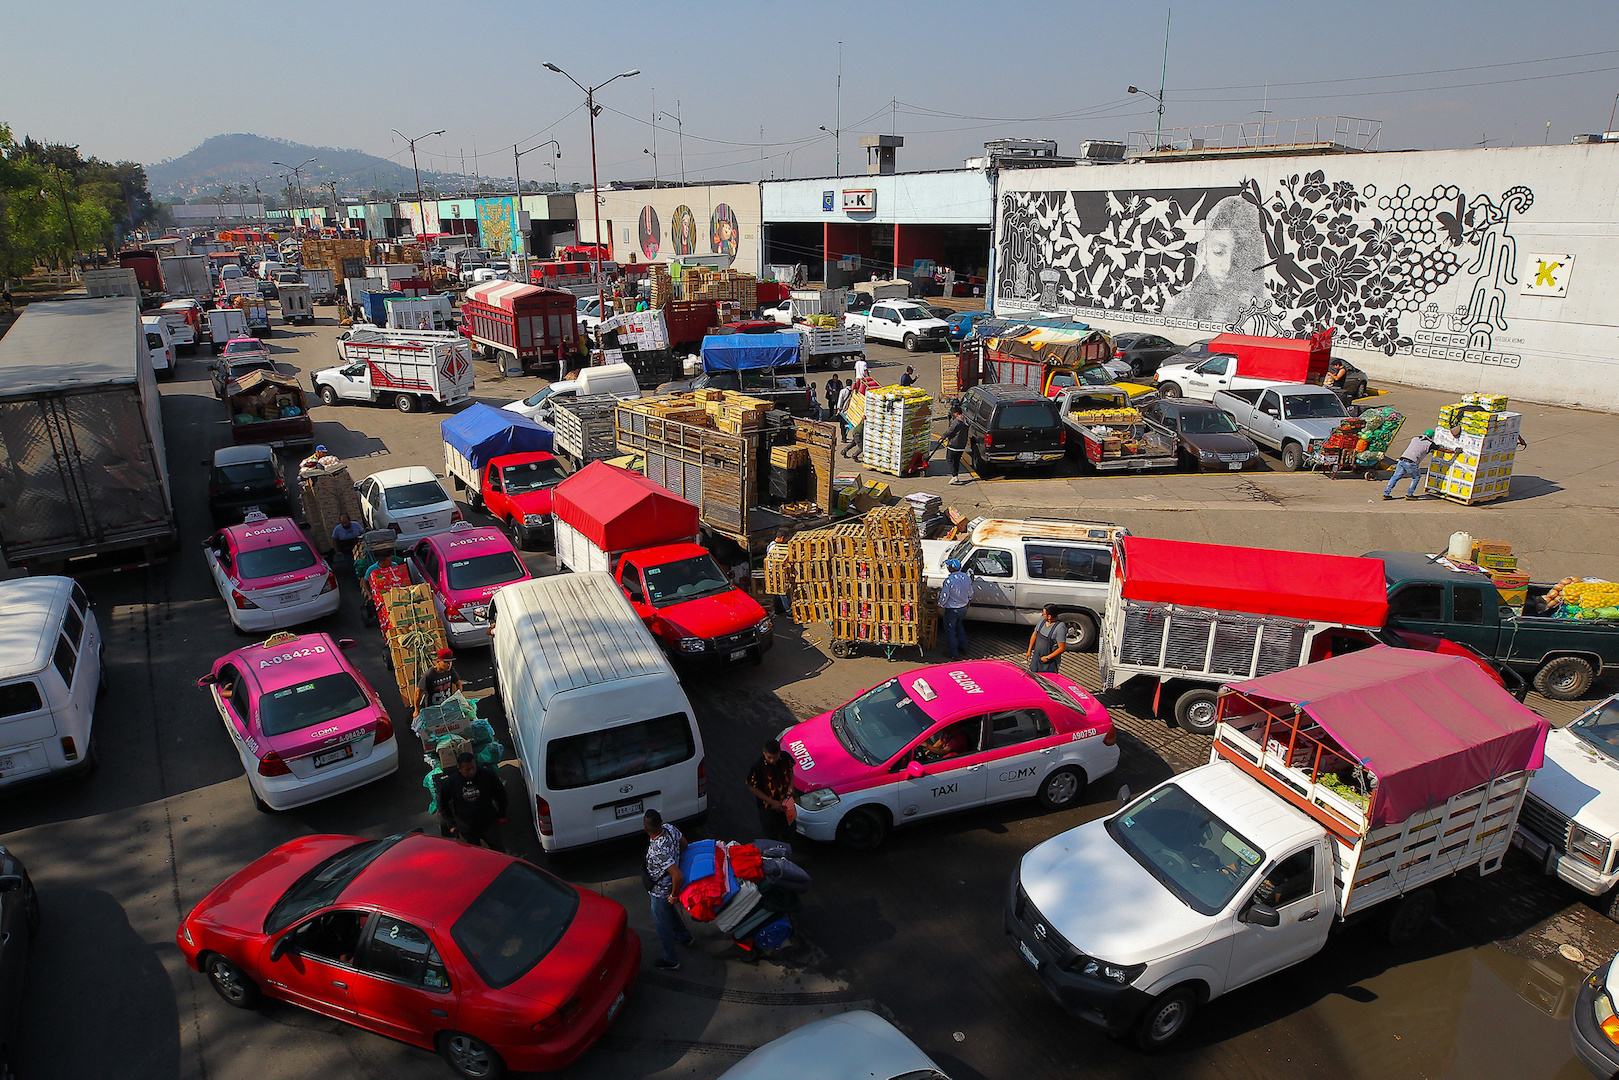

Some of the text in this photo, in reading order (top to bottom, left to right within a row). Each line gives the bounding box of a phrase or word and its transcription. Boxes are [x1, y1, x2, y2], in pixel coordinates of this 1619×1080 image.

[1536, 261, 1560, 287] K
[260, 646, 326, 669] A-0842-D
[948, 670, 985, 694] A9075D
[310, 726, 339, 738] CDMX
[1072, 728, 1097, 741] A9075D
[788, 740, 816, 771] A9075D
[999, 766, 1036, 782] CDMX
[931, 783, 958, 798] TAXI
